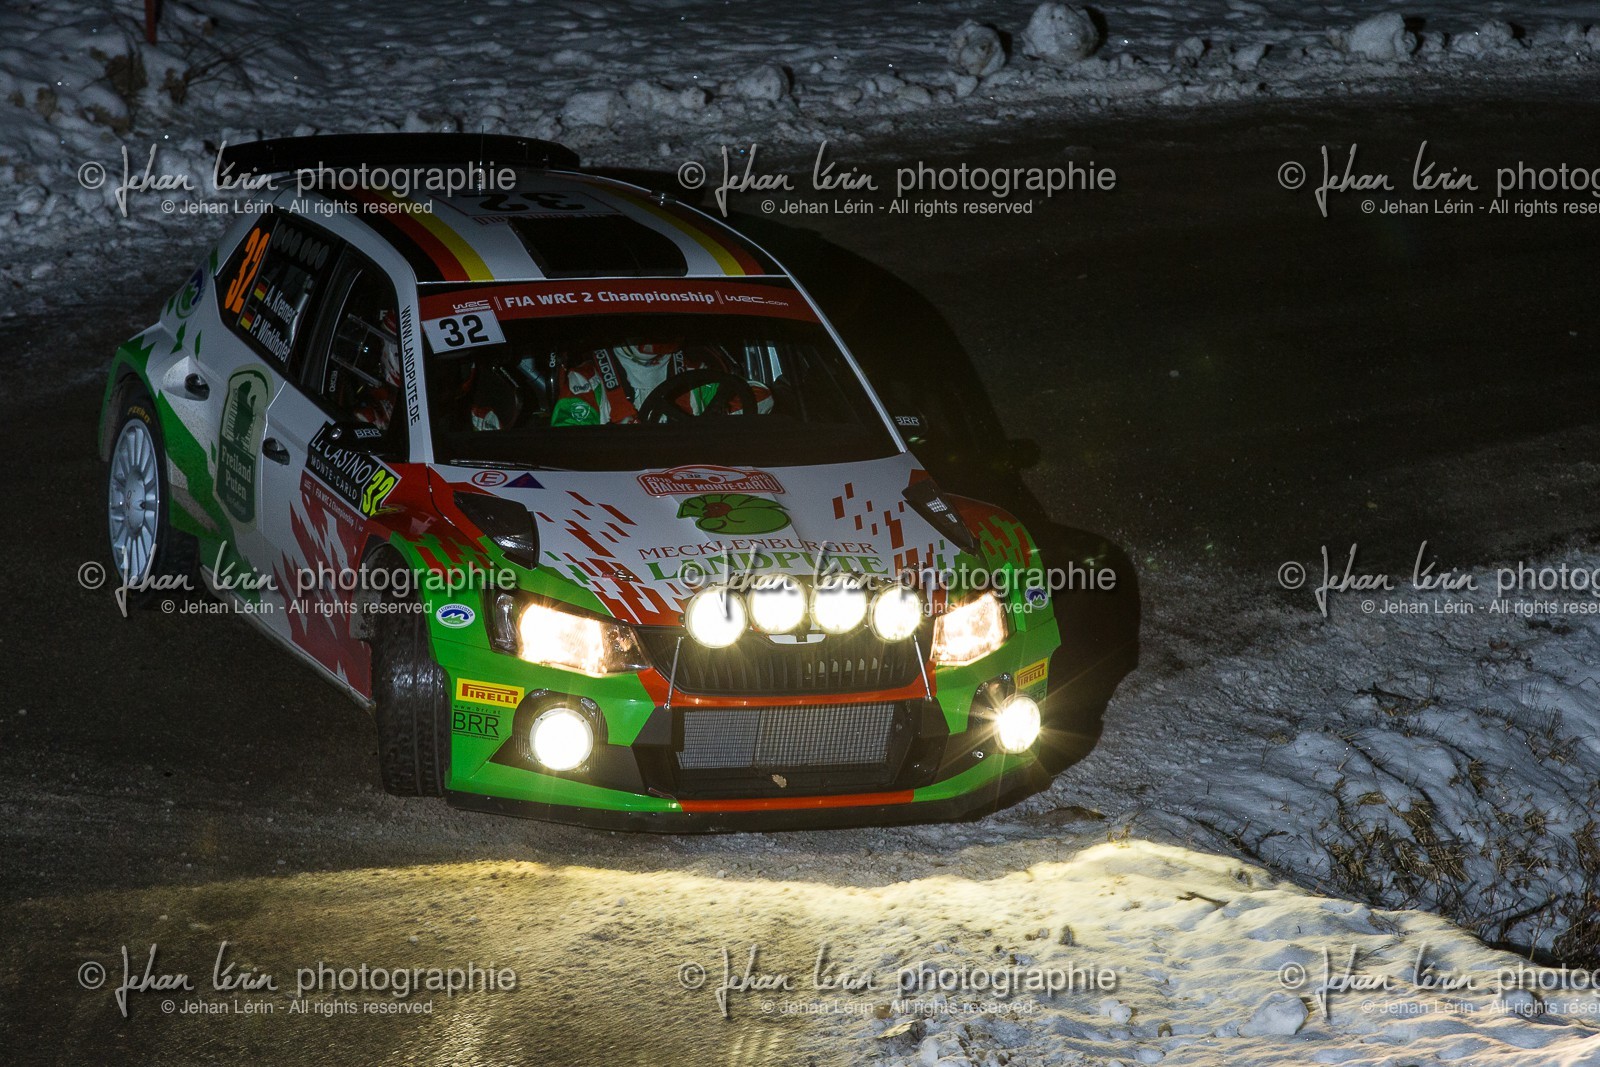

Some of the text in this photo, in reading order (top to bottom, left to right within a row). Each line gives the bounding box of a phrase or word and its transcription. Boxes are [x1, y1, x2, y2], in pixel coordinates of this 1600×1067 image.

[224, 226, 271, 314] 32
[504, 296, 535, 308] FIA
[536, 292, 577, 306] WRC
[581, 291, 594, 302] 2
[597, 289, 715, 305] Championship
[438, 314, 490, 347] 32
[401, 304, 420, 426] WWW.LANDPUTE.DE
[310, 454, 358, 501] MONTE-CARLO
[323, 444, 373, 484] CASINO
[361, 469, 395, 518] 32
[649, 478, 777, 494] RALLYE MONTE-CARLO
[638, 537, 879, 560] MECKLENBURGER
[1017, 662, 1045, 687] PIRELLI
[462, 683, 519, 705] PIRELLI
[452, 711, 499, 736] BRR
